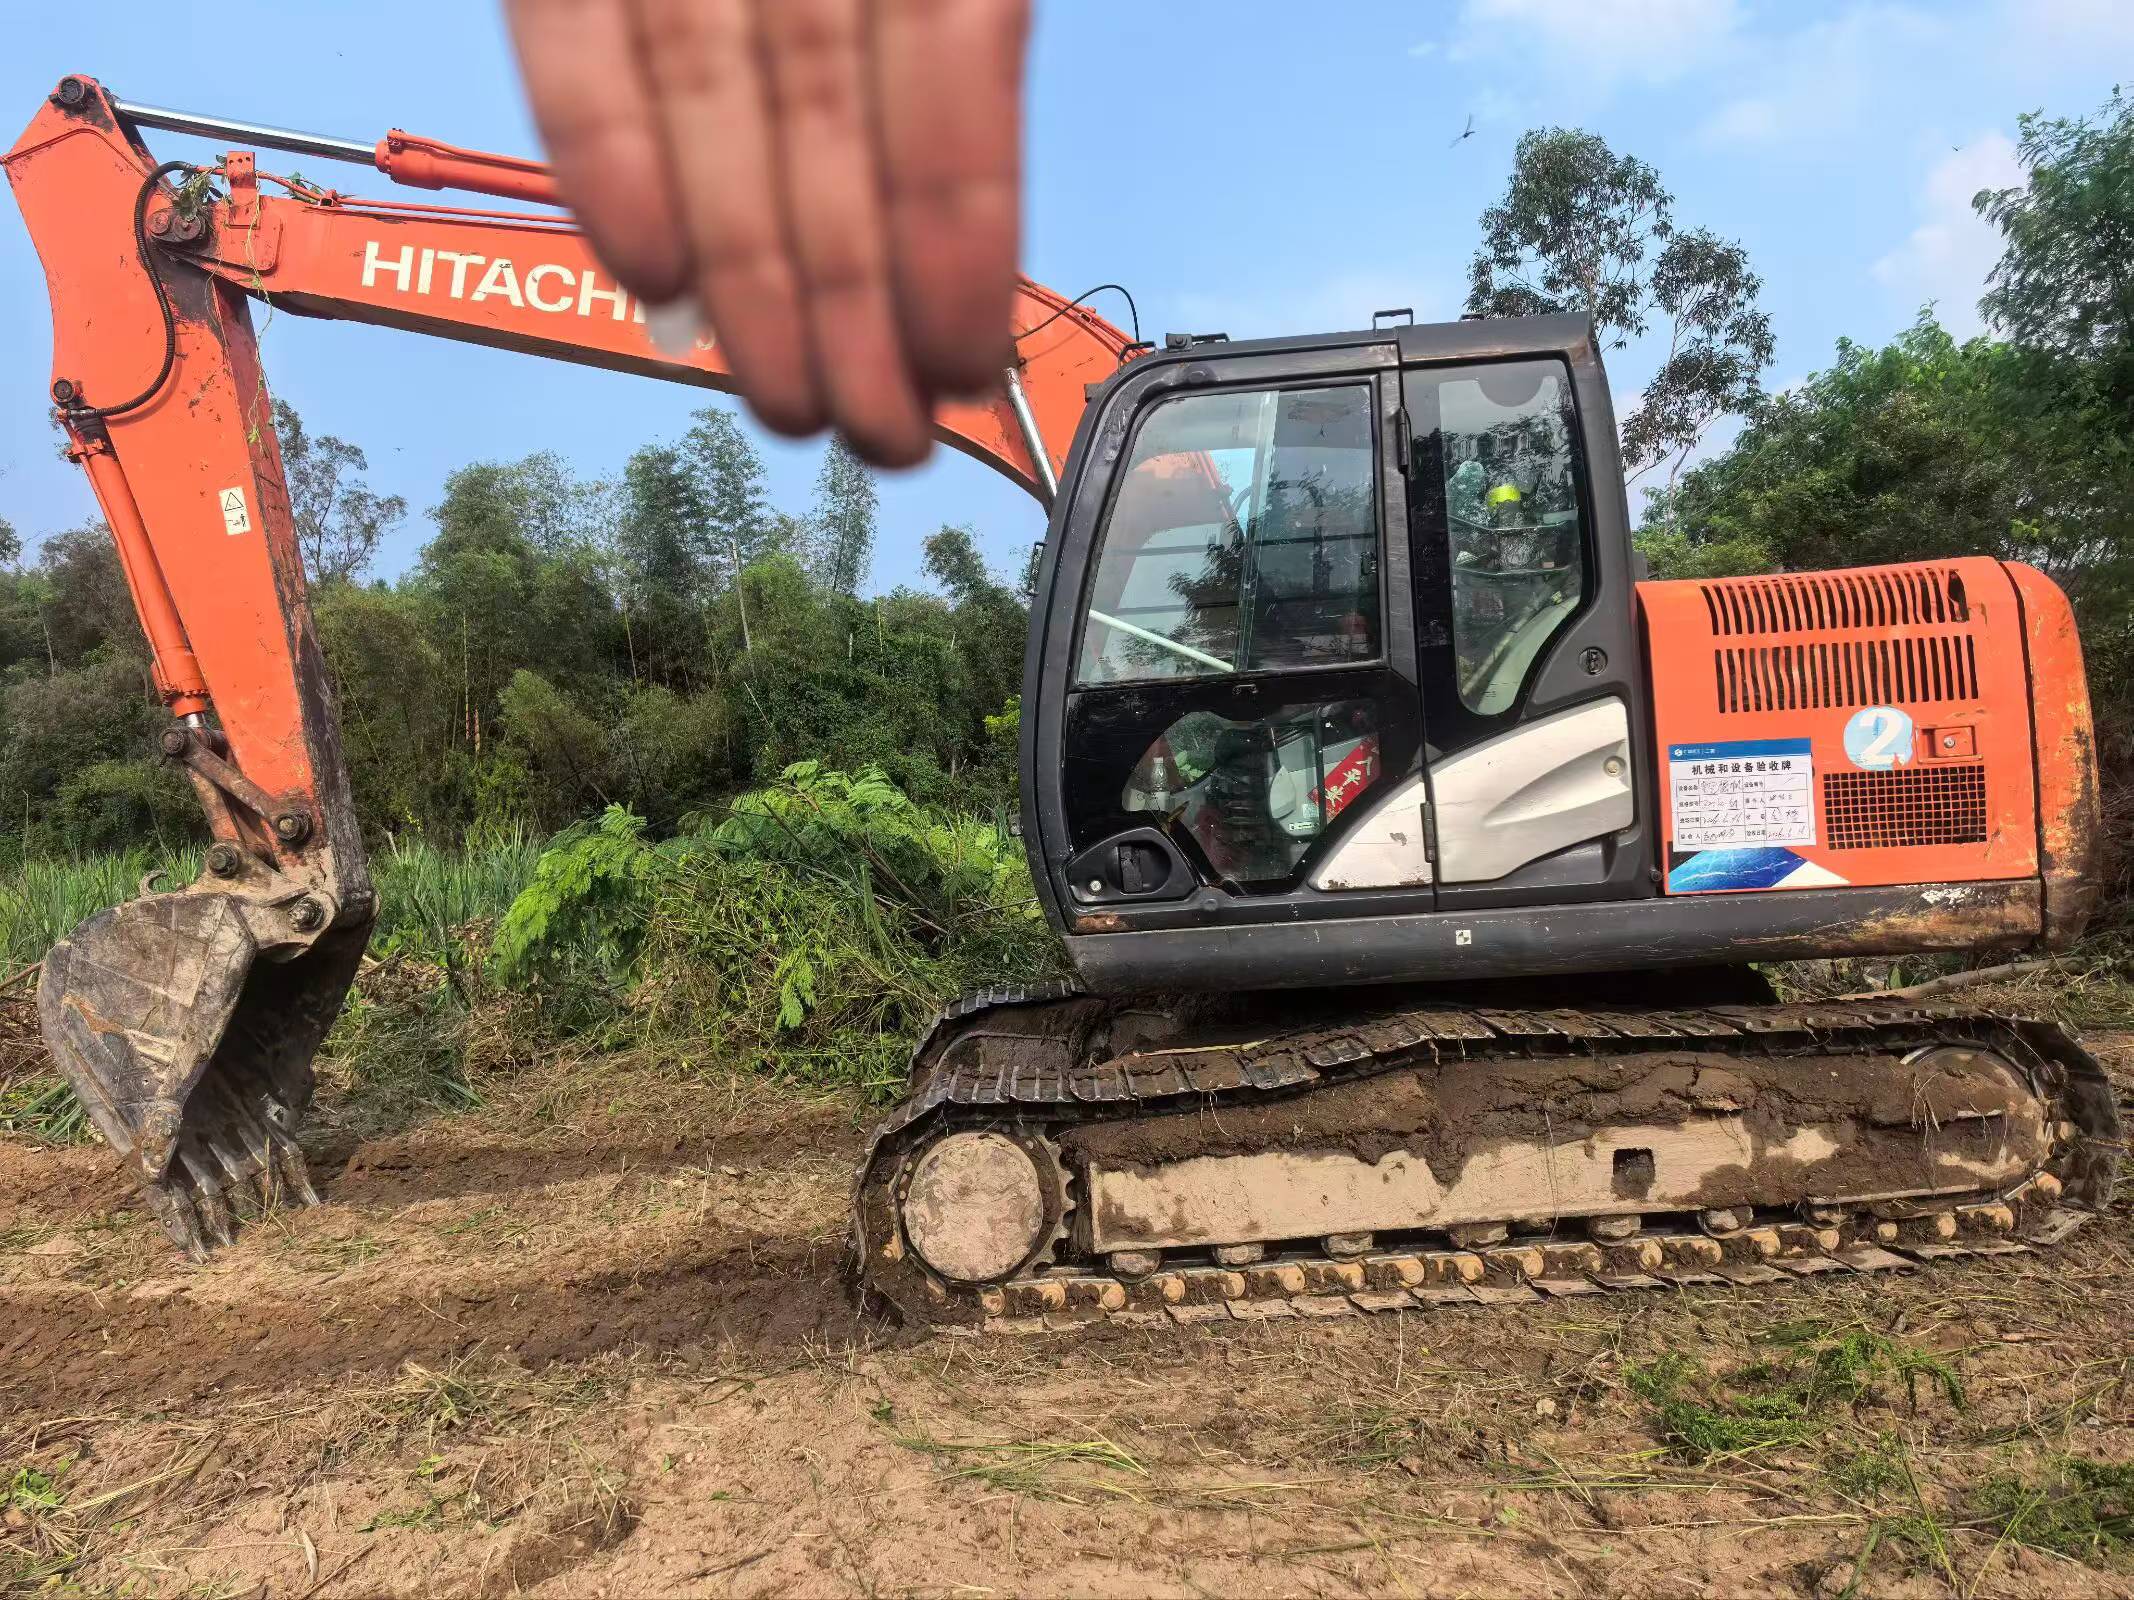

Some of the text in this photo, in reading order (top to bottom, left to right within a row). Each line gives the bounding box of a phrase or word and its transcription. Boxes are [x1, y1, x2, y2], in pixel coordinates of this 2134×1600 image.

[1858, 707, 1906, 766] 2
[1691, 760, 1792, 776] 机械和设备验收牌
